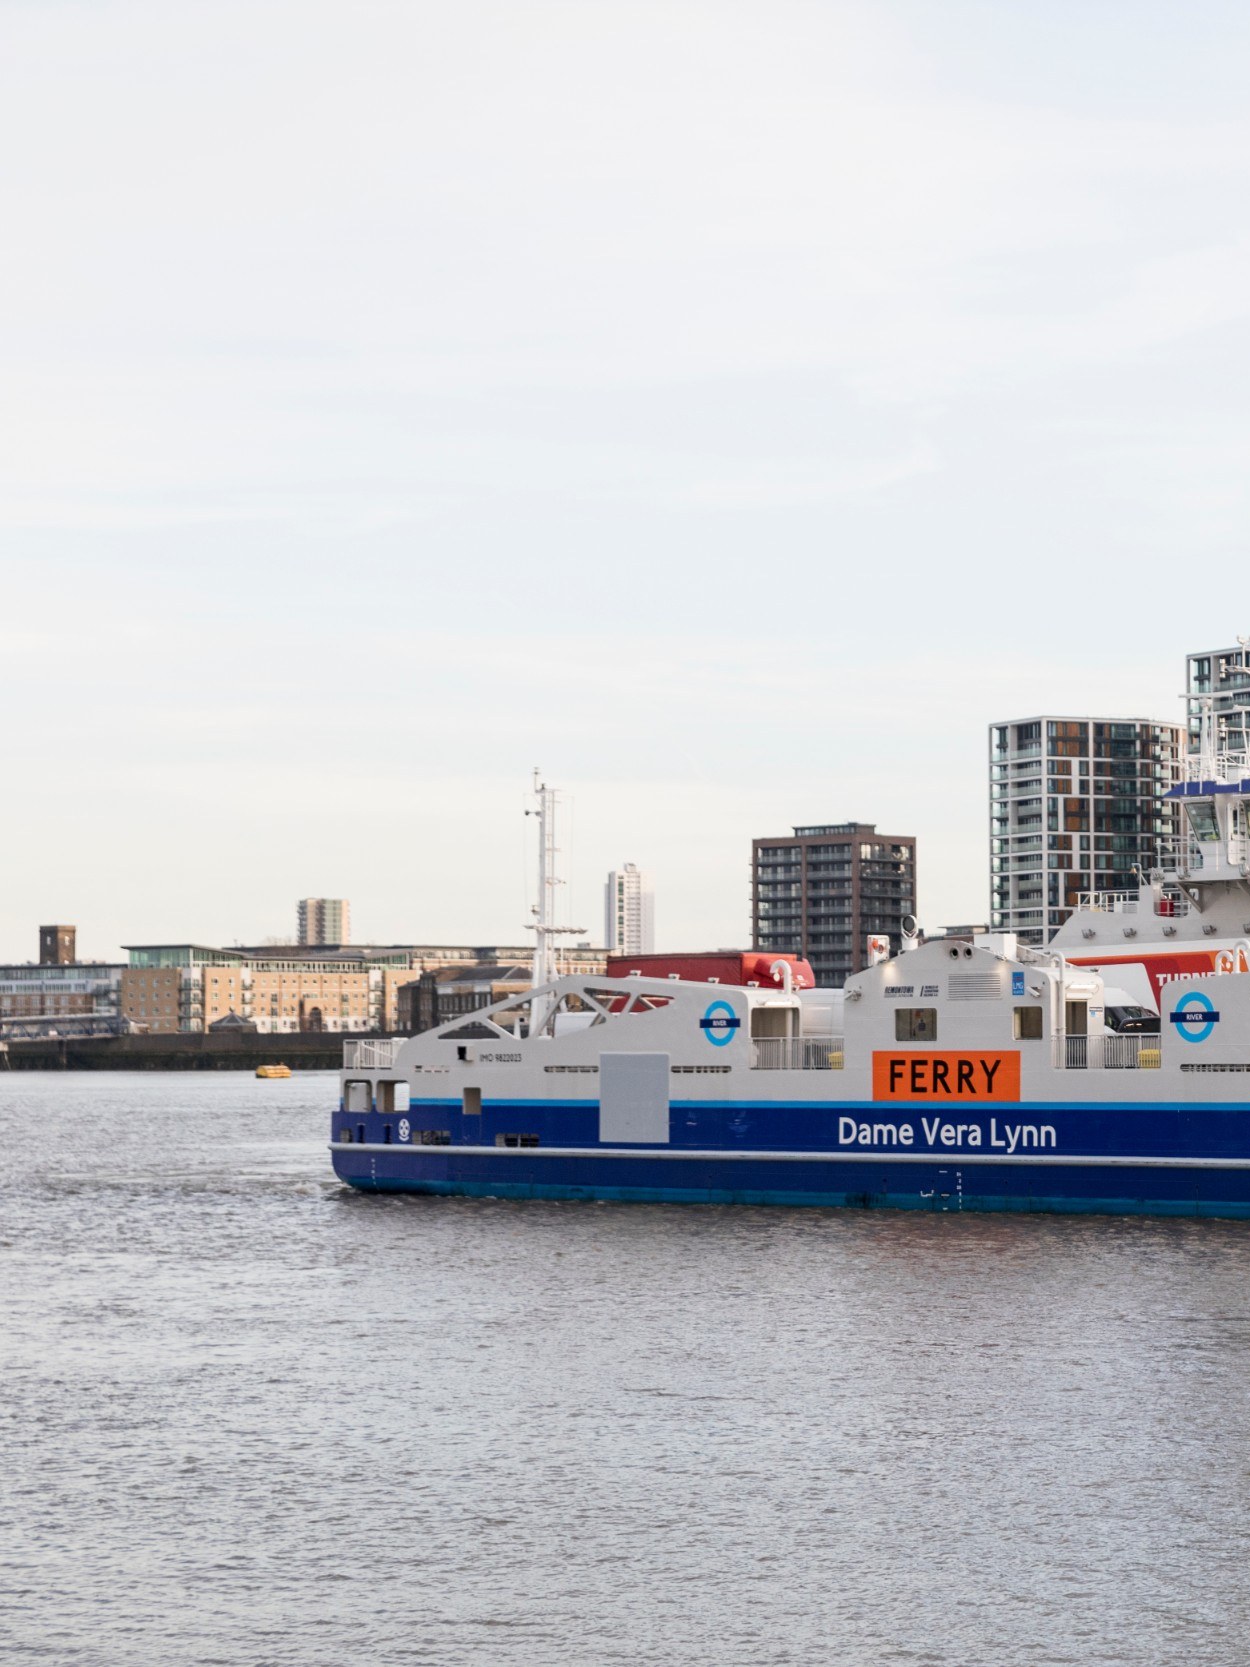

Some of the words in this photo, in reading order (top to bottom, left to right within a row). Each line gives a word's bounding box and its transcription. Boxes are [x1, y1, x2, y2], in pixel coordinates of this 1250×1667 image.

[1186, 1013, 1203, 1021] RIVER
[479, 1053, 495, 1063] IMO
[889, 1059, 1001, 1094] FERRY
[838, 1116, 914, 1146] Dame
[921, 1117, 982, 1147] Vera
[990, 1117, 1057, 1154] Lynn
